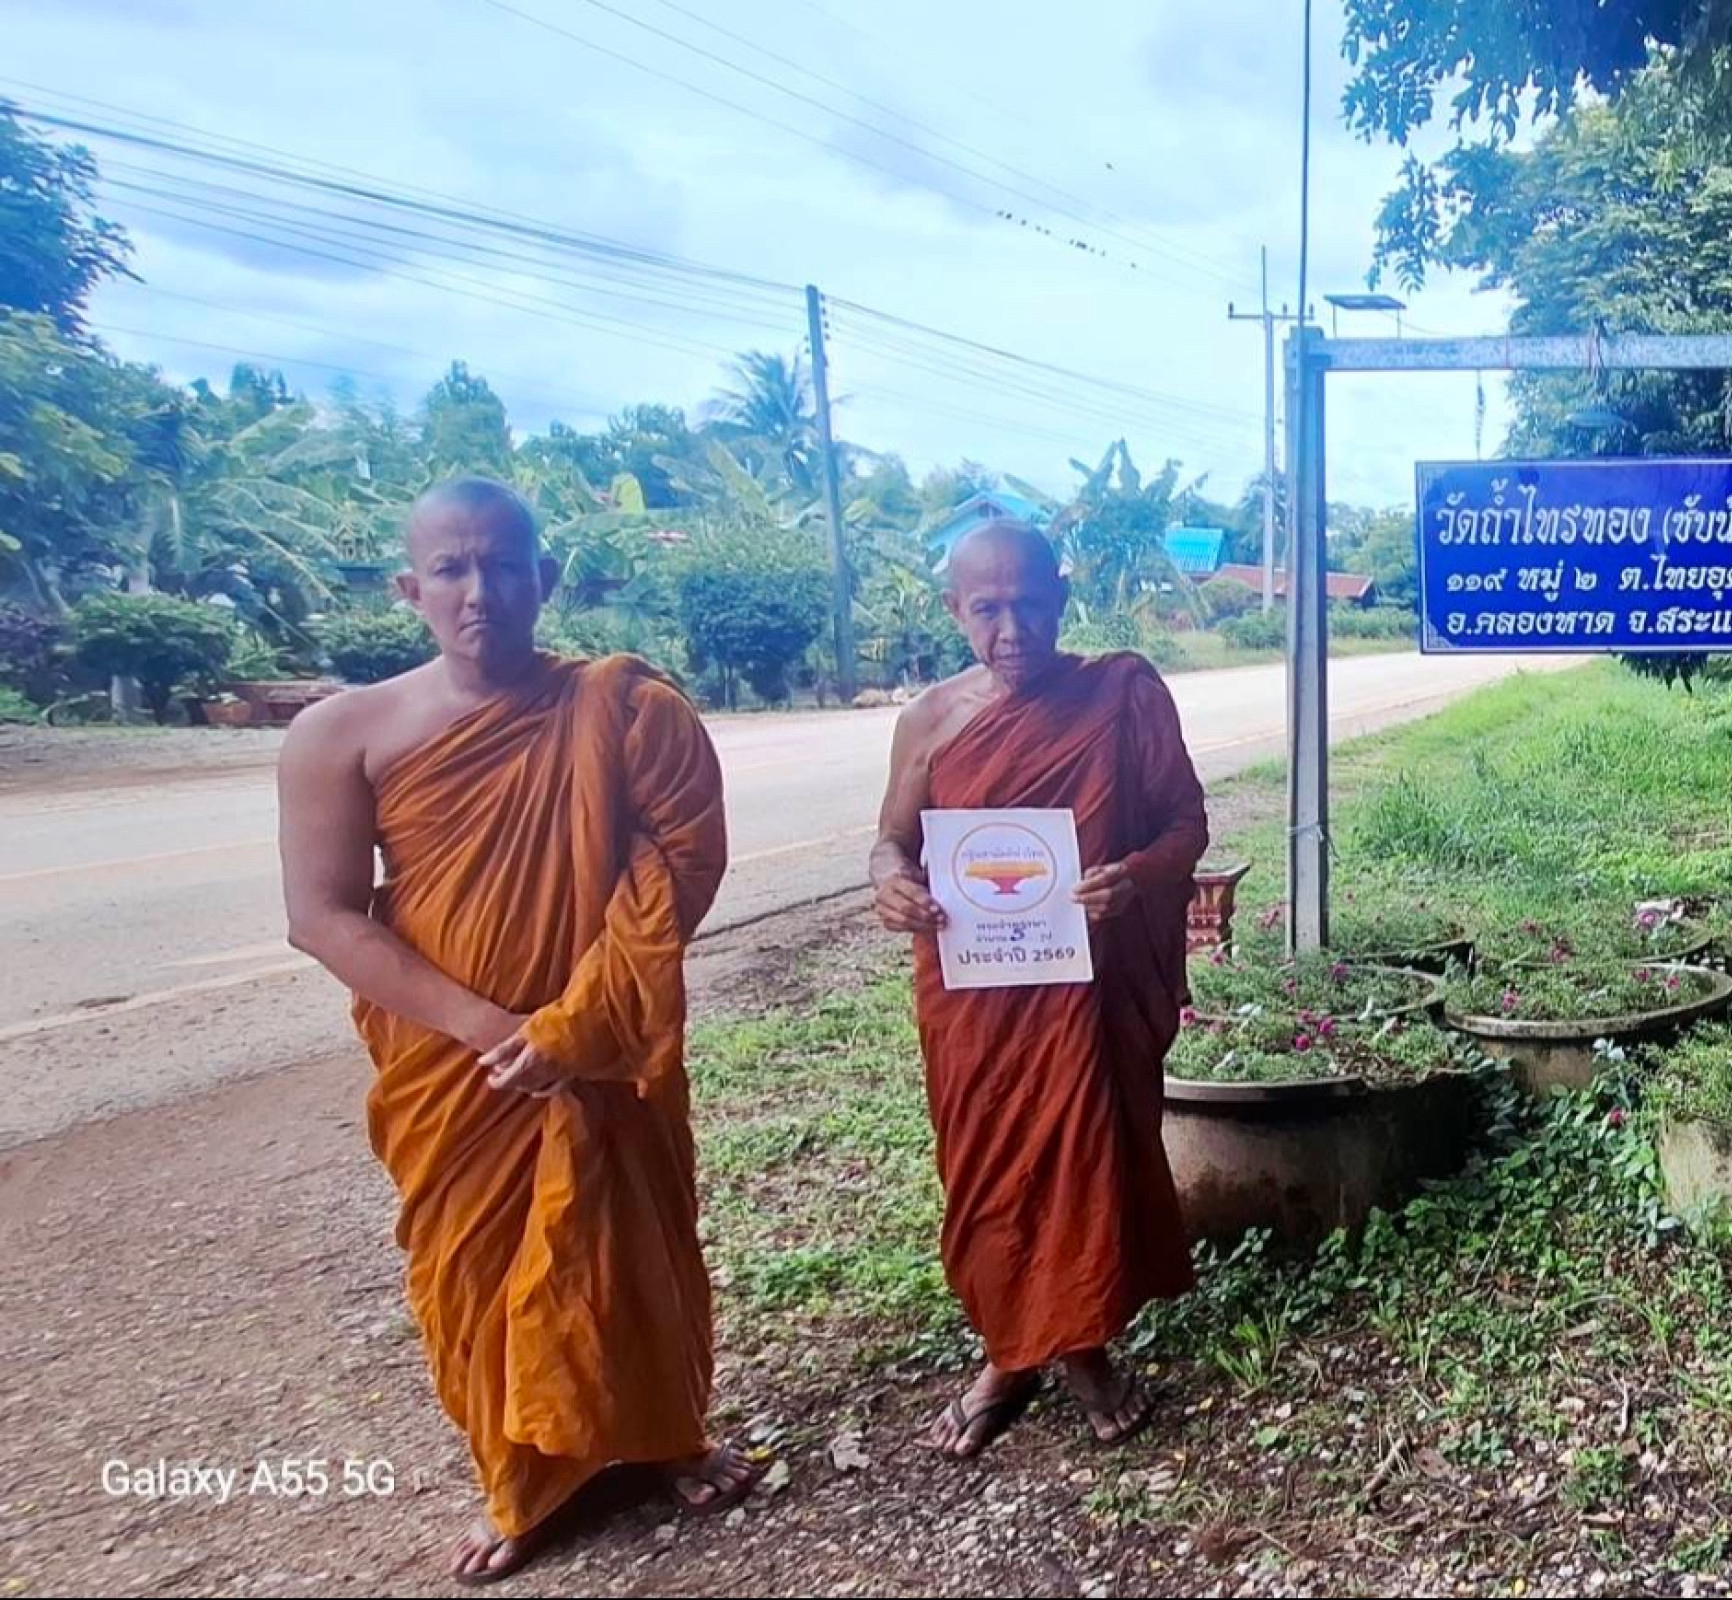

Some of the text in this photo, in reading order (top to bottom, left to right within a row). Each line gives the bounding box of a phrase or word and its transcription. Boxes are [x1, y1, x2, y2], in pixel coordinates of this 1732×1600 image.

[1436, 477, 1652, 545] วัดถ้ำไทรทอง
[1446, 566, 1508, 592] ๑๑๙
[1517, 560, 1564, 603] หมู่
[1573, 566, 1597, 592] ๒
[1447, 608, 1614, 635] อ.คลองหาด
[958, 945, 1076, 966] ประจำปี 2569
